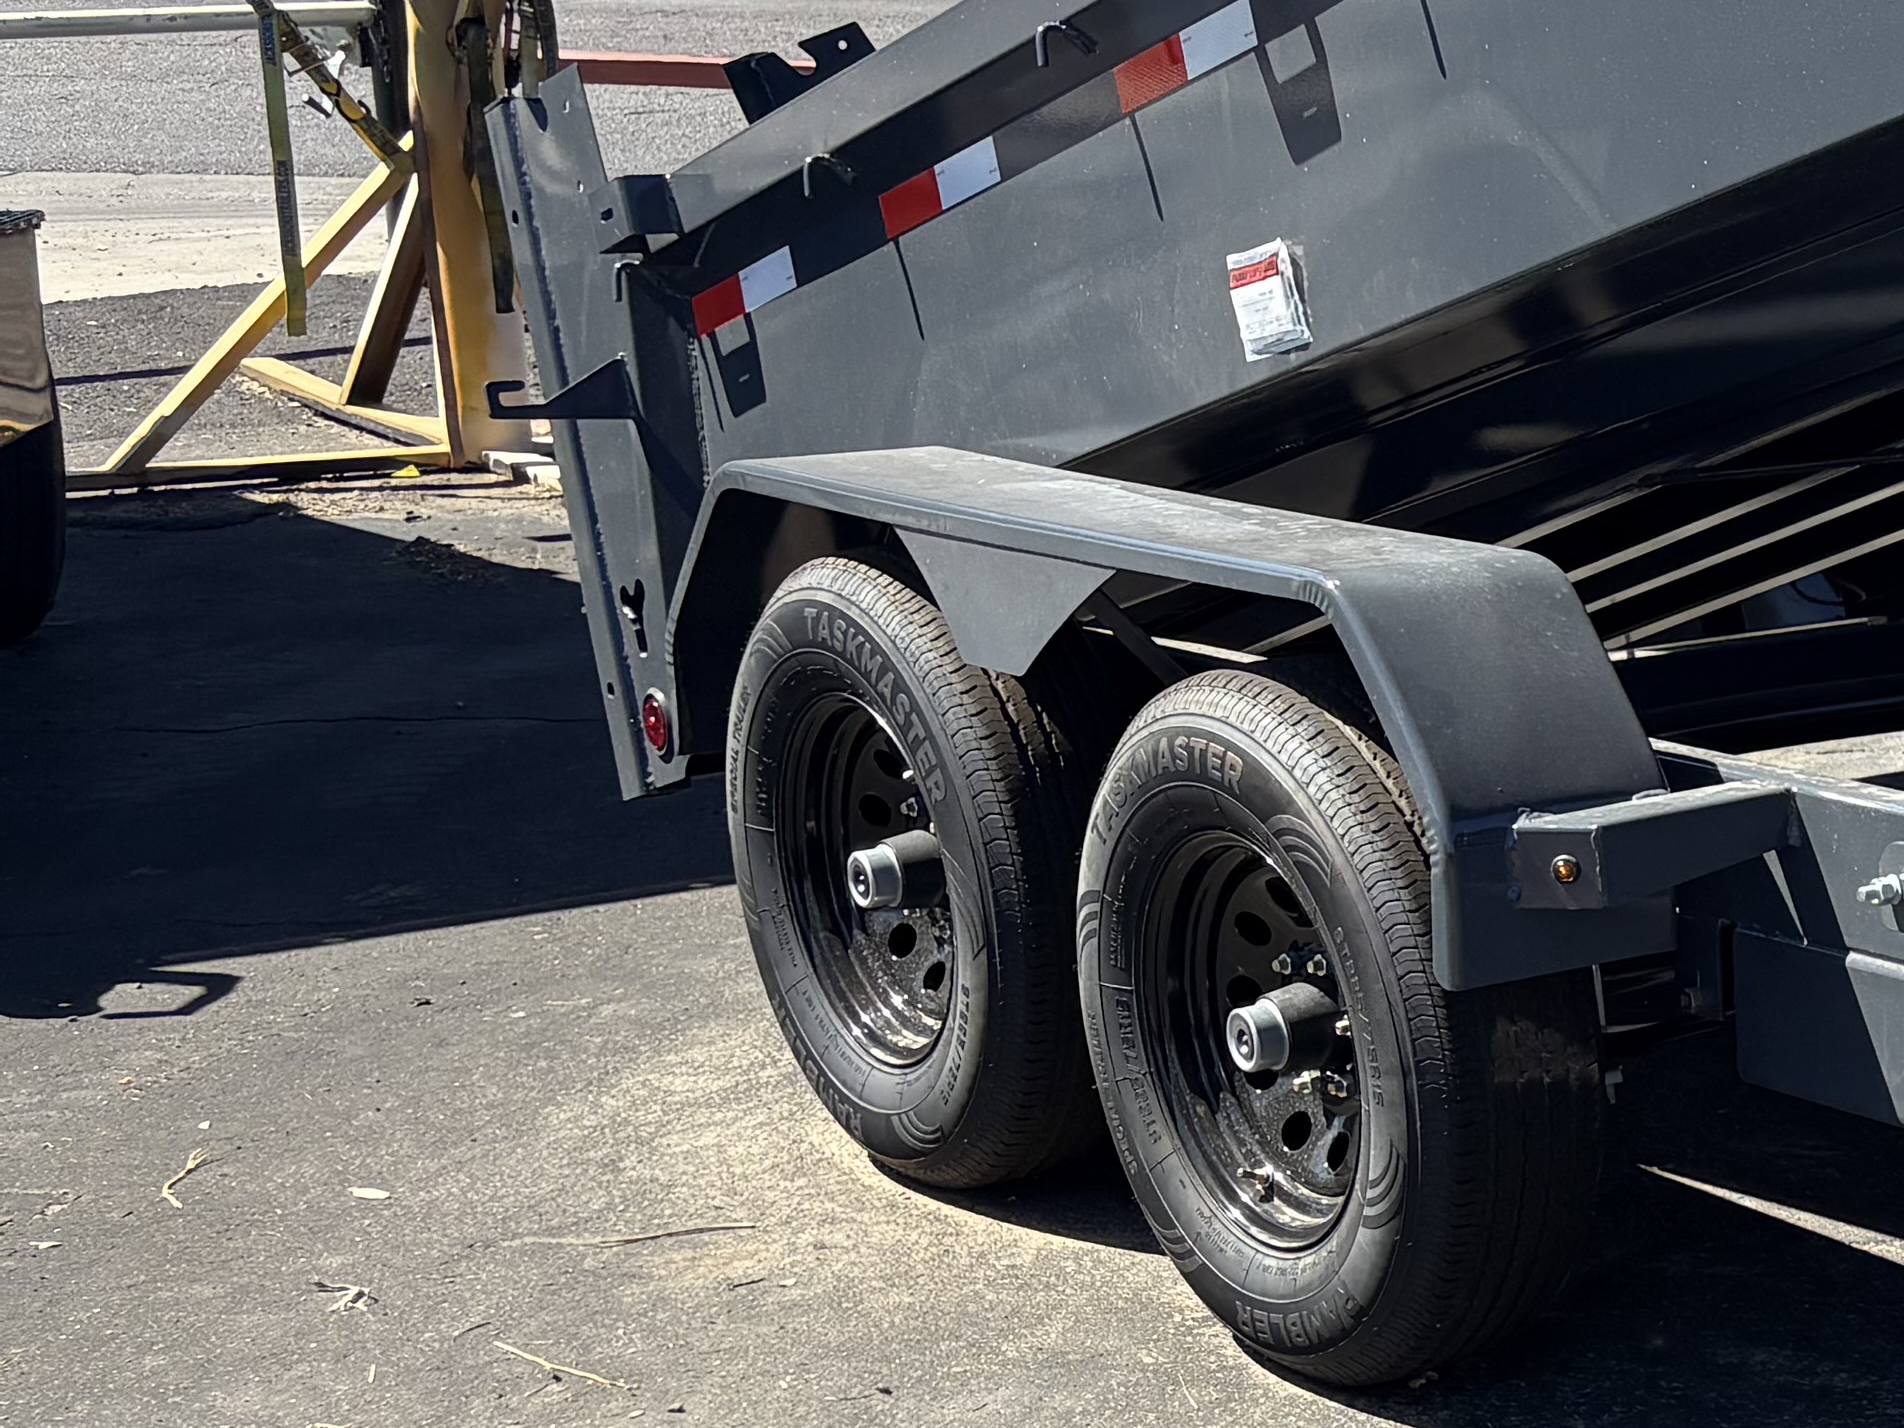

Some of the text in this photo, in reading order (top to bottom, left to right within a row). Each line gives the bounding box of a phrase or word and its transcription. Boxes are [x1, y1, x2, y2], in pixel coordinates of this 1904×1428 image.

[803, 607, 947, 805] TASKMASTER
[1091, 735, 1244, 846] TASKMASTER
[1236, 1279, 1367, 1349] RAMBLER
